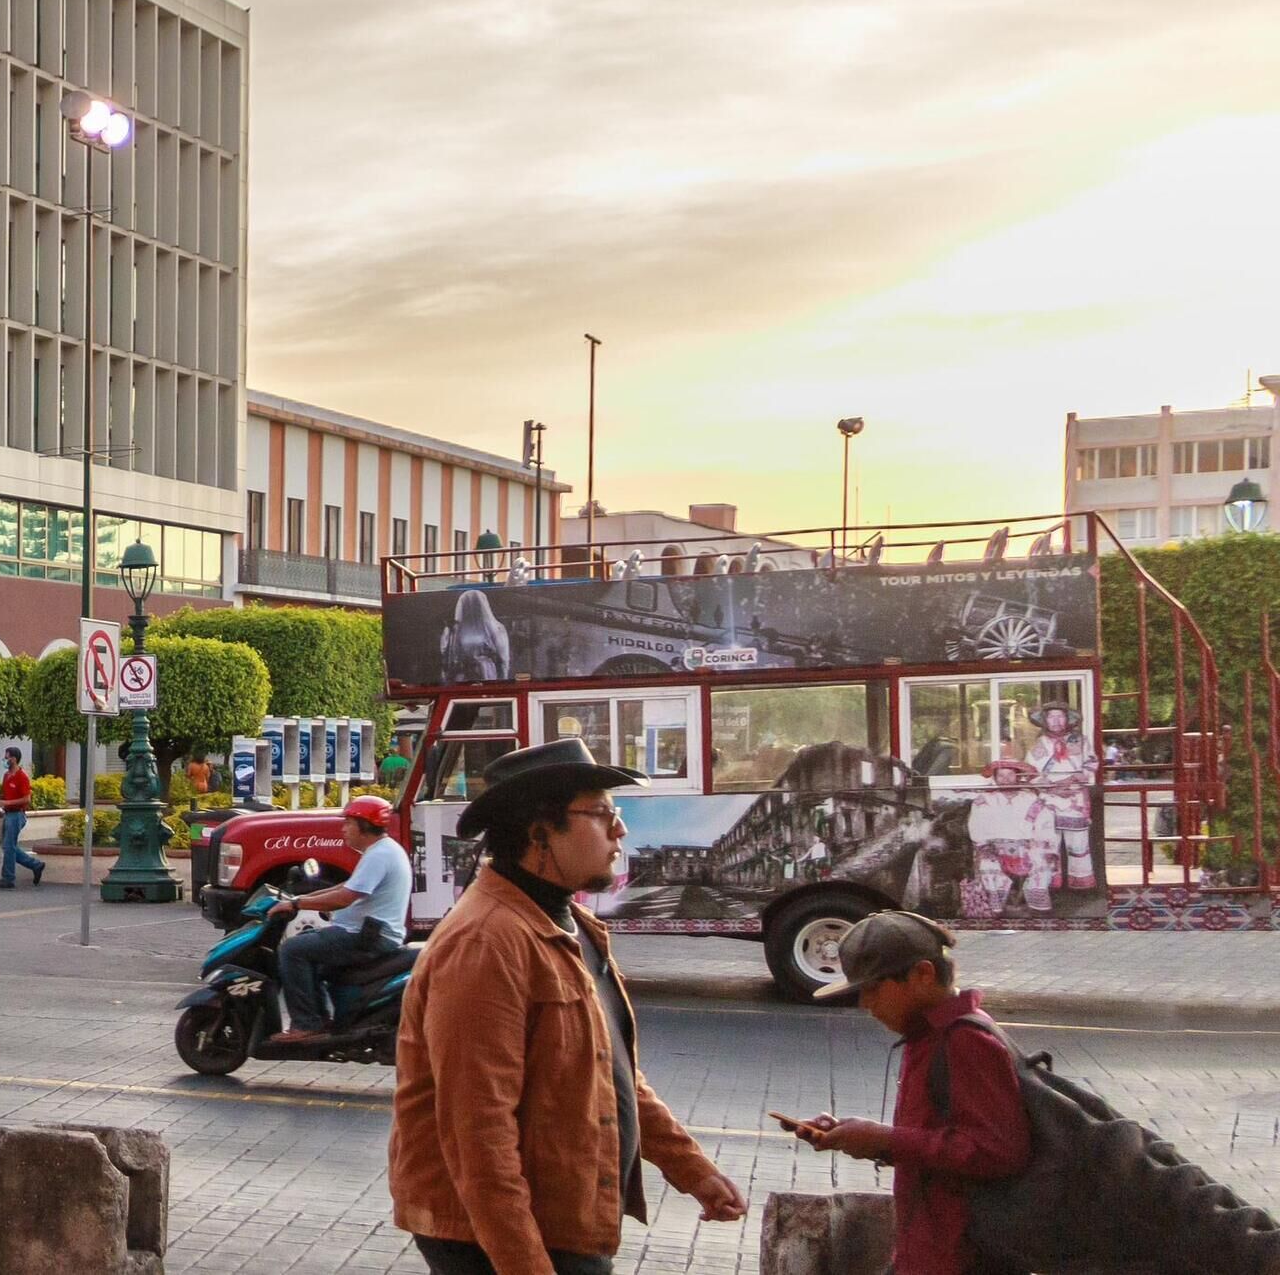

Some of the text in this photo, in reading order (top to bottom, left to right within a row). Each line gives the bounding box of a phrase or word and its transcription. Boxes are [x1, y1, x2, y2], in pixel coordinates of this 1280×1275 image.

[880, 567, 1081, 586] TOUR MITOS Y LEYENDAS
[608, 635, 675, 653] HIDALGO
[705, 654, 754, 664] CORINCA
